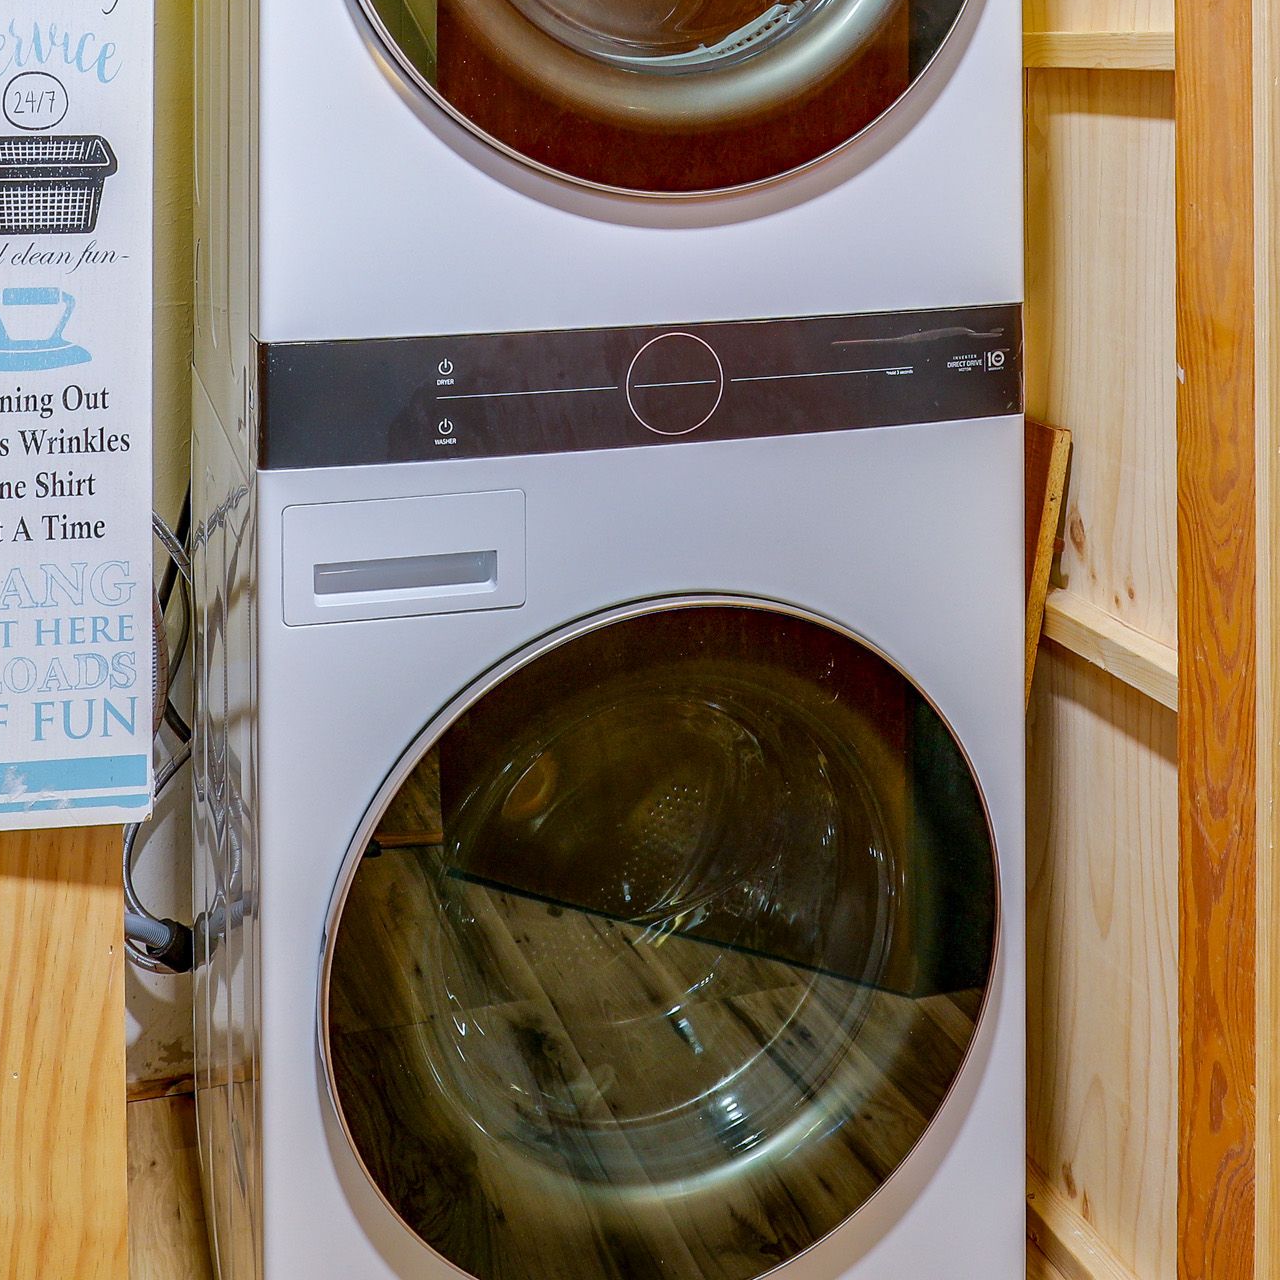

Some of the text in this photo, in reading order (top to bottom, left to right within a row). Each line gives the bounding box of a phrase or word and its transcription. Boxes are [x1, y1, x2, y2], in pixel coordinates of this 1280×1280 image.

[13, 90, 56, 114] 24/7
[9, 242, 73, 267] clean
[947, 358, 983, 368] DIRECT DRIVE
[436, 378, 455, 386] DRYER
[62, 384, 111, 412] Out
[18, 427, 131, 457] Wrinkles
[434, 437, 457, 446] WASHER
[35, 470, 97, 500] Shirt
[11, 516, 34, 542] A
[41, 514, 107, 541] Time
[34, 614, 135, 646] HERE
[31, 696, 140, 742] FUN
